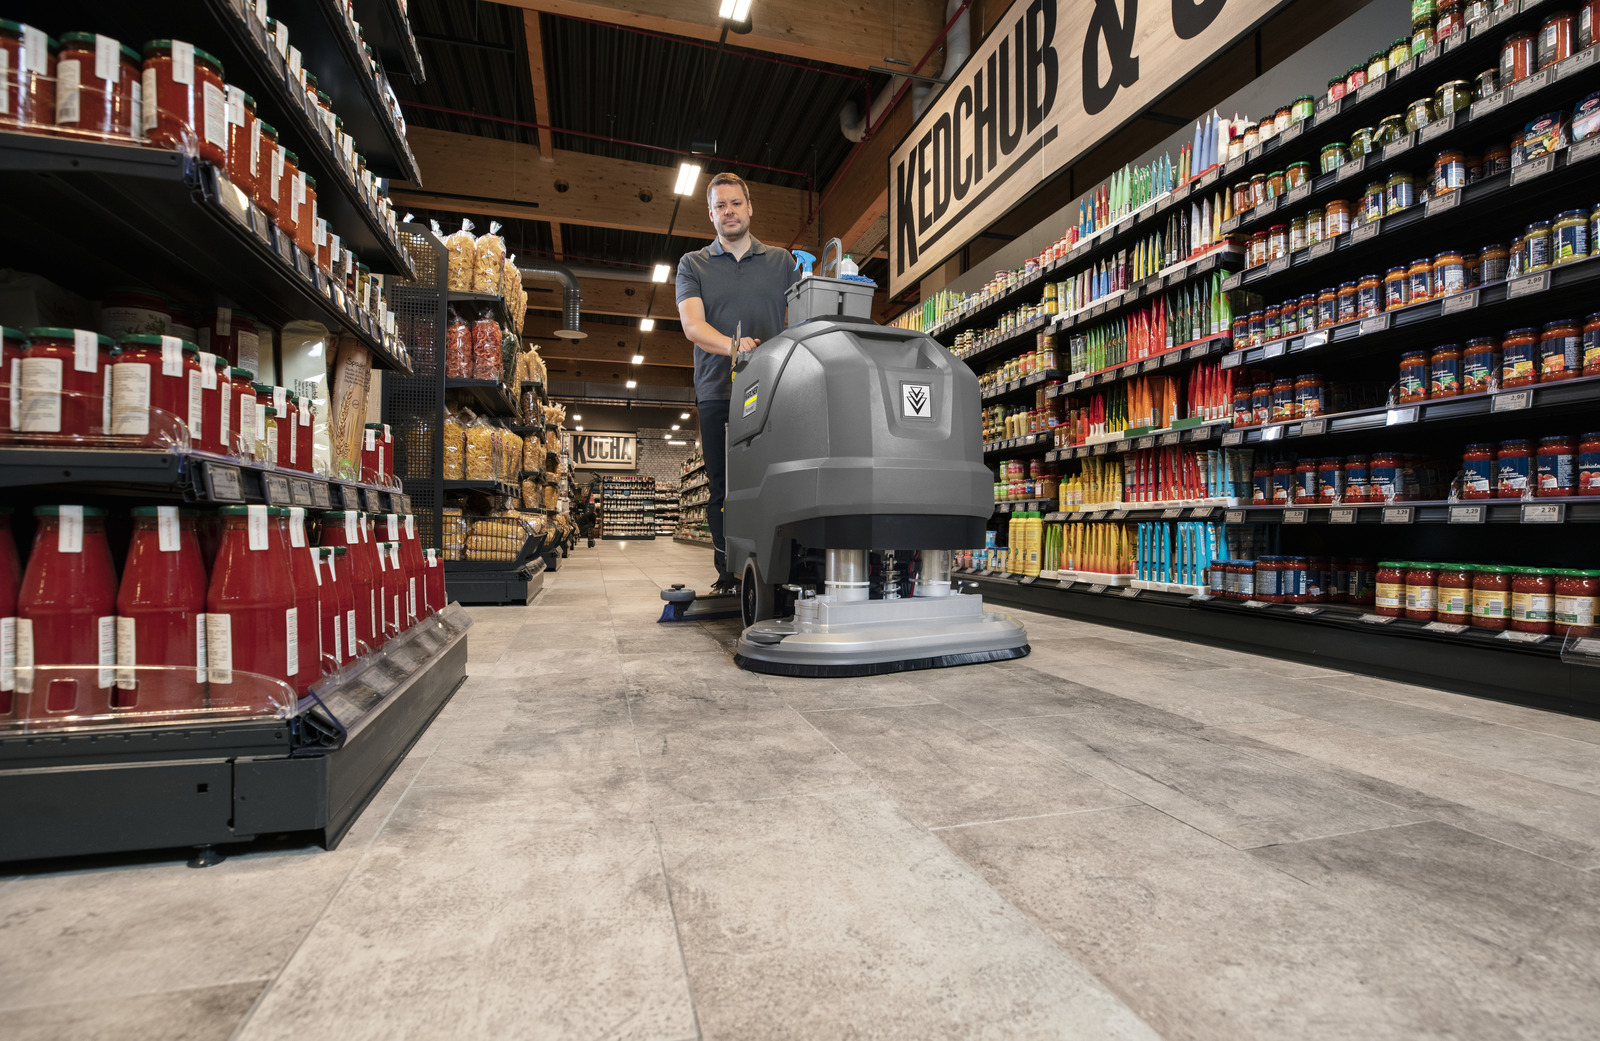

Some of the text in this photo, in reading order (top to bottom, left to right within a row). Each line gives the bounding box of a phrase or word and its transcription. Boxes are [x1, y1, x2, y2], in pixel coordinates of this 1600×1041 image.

[897, 0, 1140, 277] KEDCHUB &
[1530, 159, 1546, 169] 2,99
[1527, 276, 1542, 285] 2,99
[1510, 393, 1525, 401] 2,99
[573, 435, 632, 464] KUCHA
